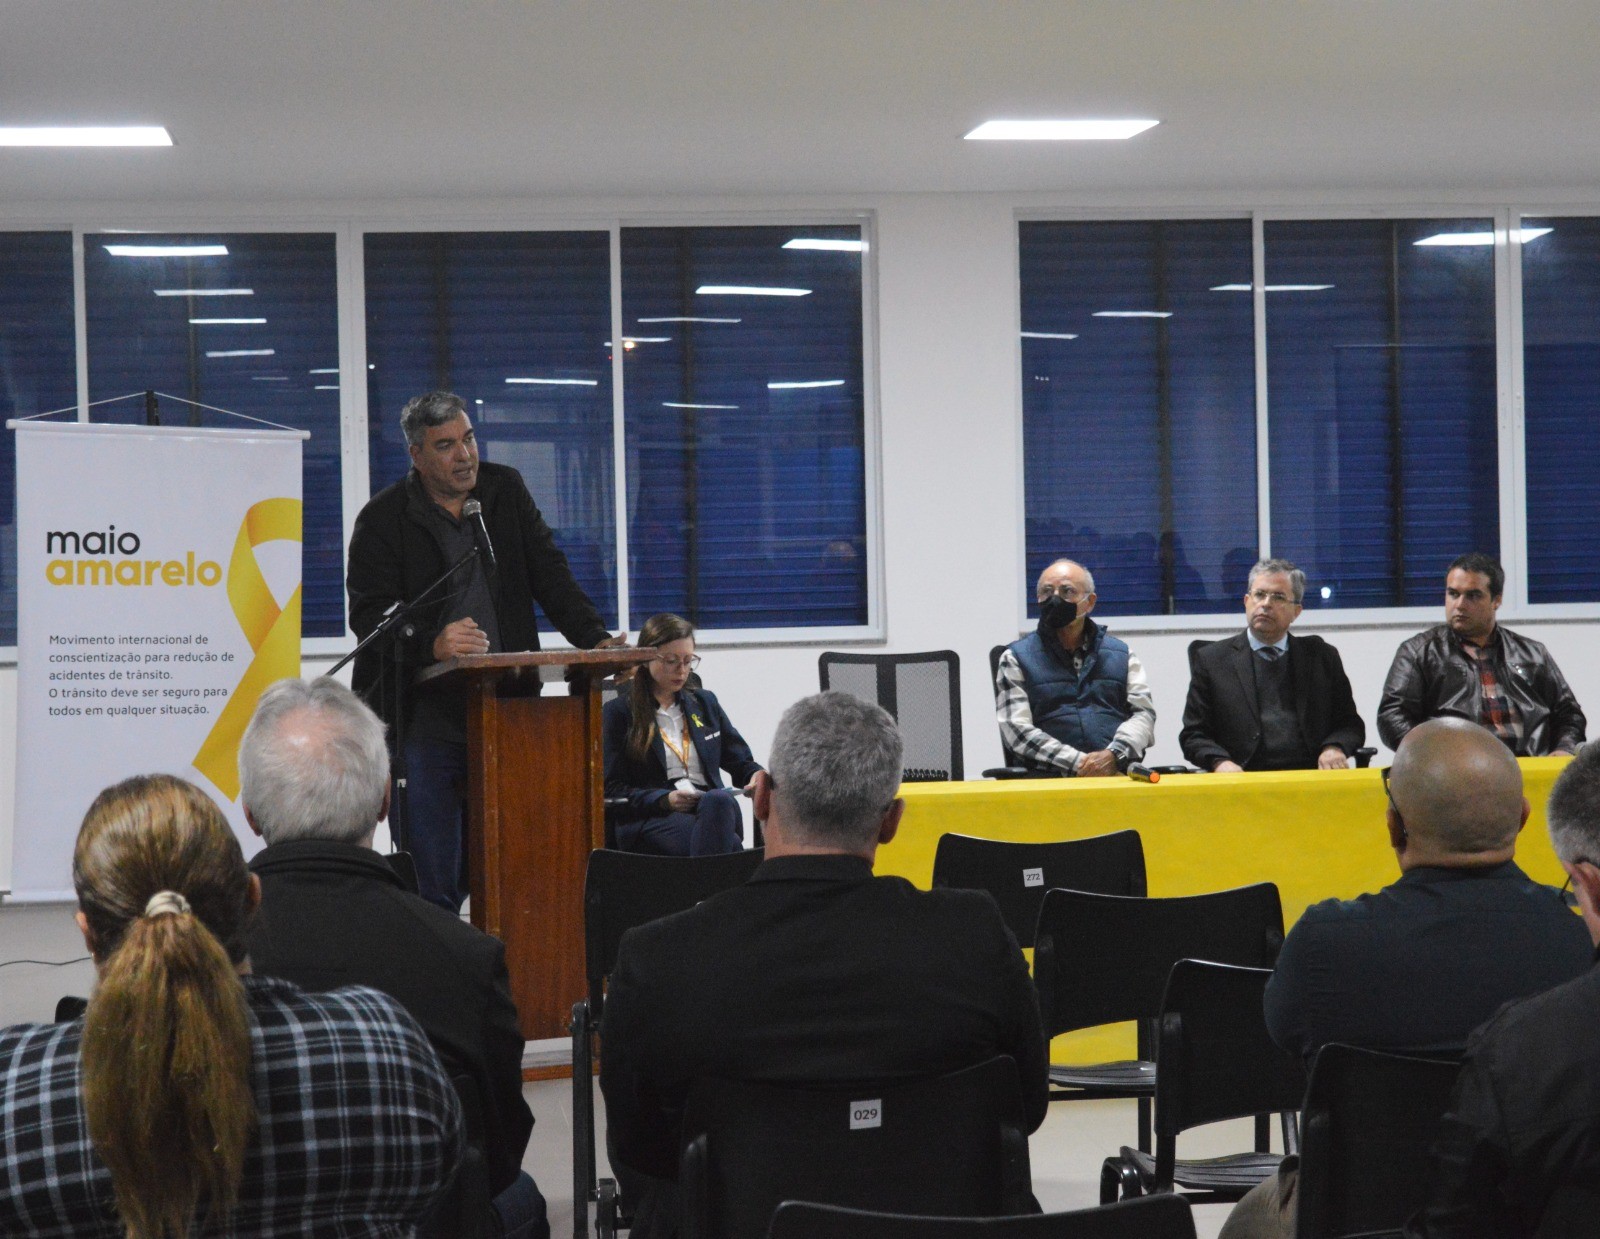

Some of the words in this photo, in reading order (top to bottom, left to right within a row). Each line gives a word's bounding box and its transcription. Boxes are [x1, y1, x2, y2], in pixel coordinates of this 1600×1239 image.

[46, 525, 140, 554] maio
[46, 551, 222, 586] amarelo
[49, 635, 115, 645] Movimento
[118, 635, 192, 645] internacional
[195, 635, 208, 645] de
[49, 652, 141, 665] conscientização
[145, 654, 170, 665] para
[173, 652, 218, 664] redução
[221, 652, 234, 662] de
[49, 669, 105, 681] acidentes
[109, 669, 123, 680] de
[126, 669, 173, 680] trânsito.
[49, 688, 58, 698] O
[61, 687, 107, 698] trânsito
[110, 687, 139, 697] deve
[142, 689, 158, 697] ser
[162, 689, 200, 700] seguro
[203, 688, 228, 698] para
[49, 705, 81, 716] todos
[85, 707, 103, 715] em
[106, 705, 156, 717] qualquer
[160, 704, 210, 716] situação.
[1026, 873, 1040, 881] 272
[854, 1109, 877, 1120] 029
